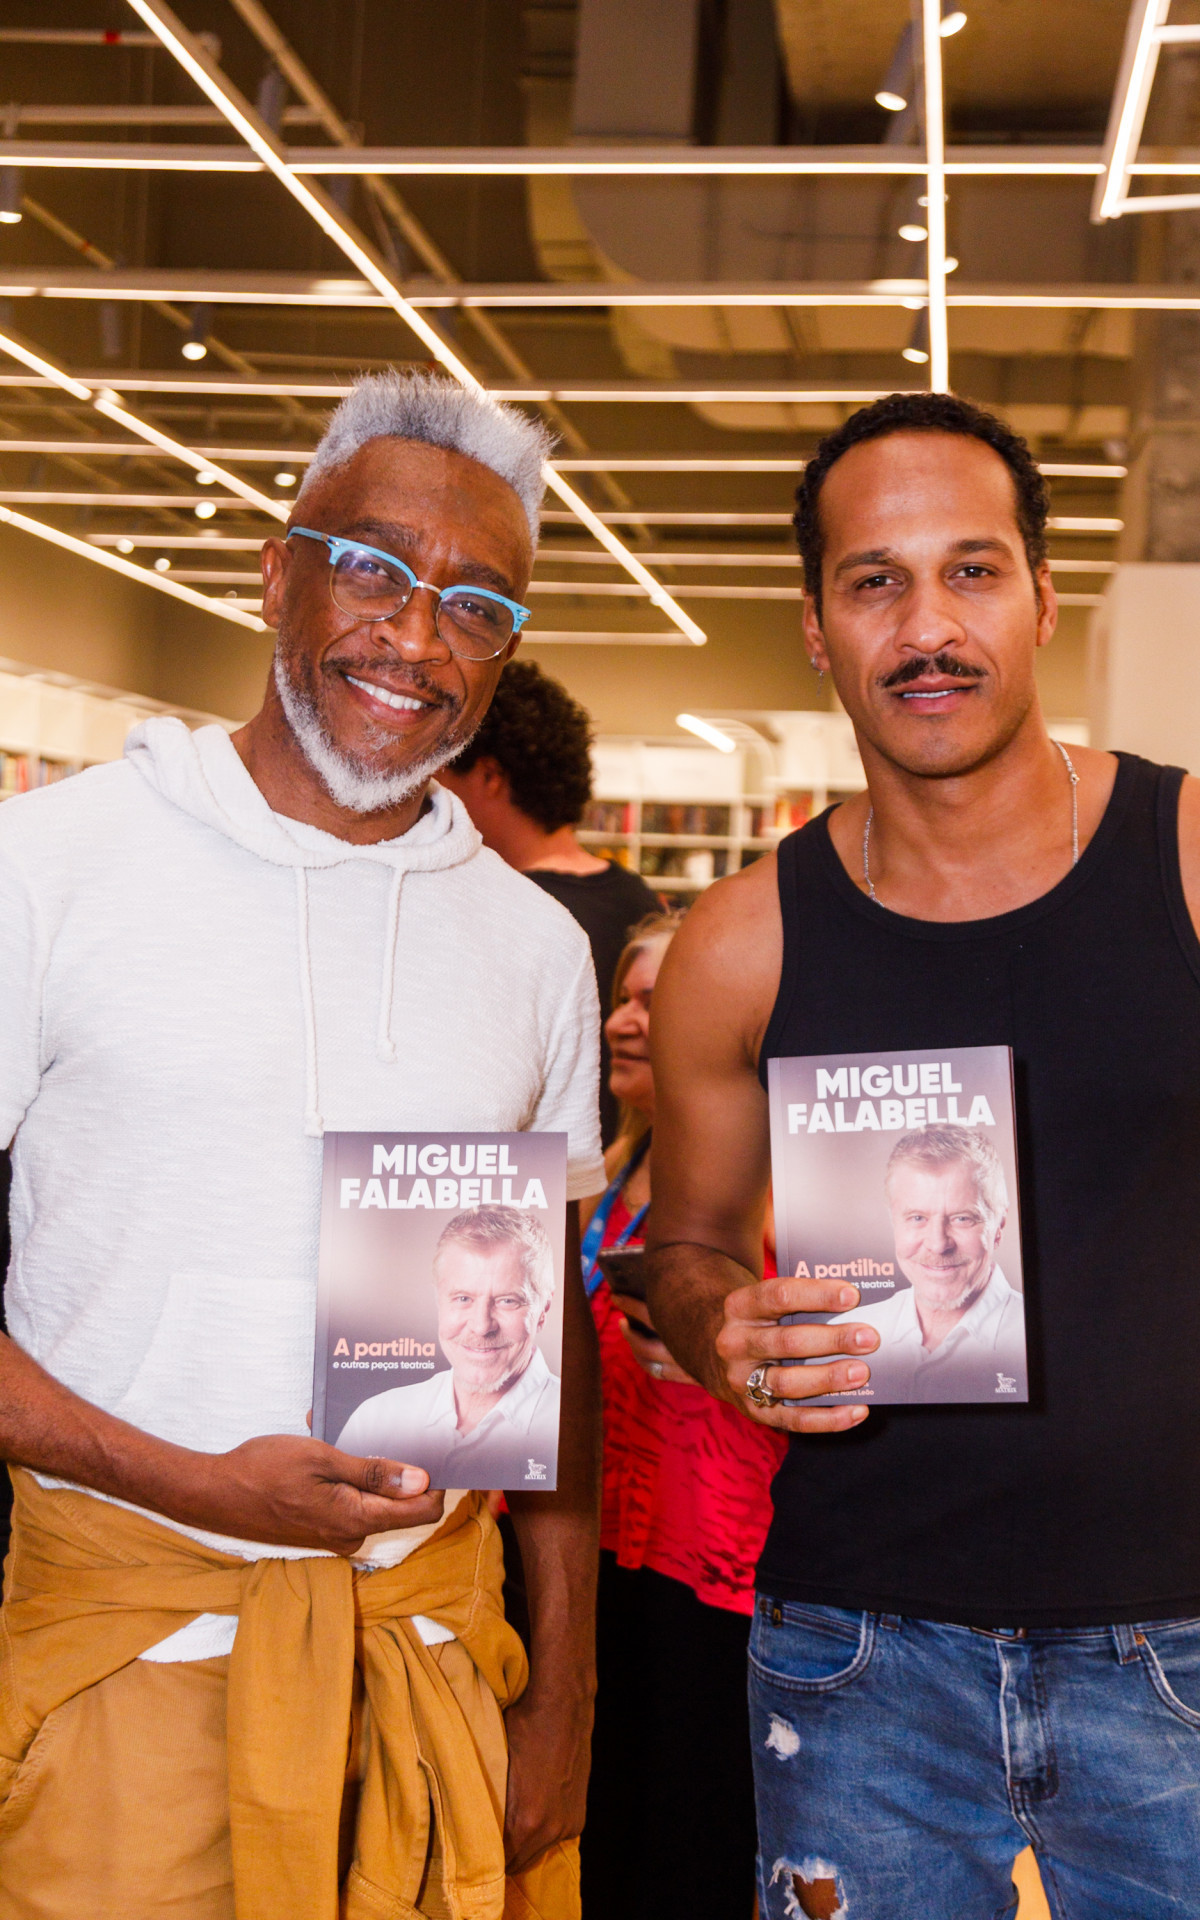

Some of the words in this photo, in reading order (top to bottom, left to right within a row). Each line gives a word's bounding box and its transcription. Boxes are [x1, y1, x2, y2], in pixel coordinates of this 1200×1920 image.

[815, 1062, 962, 1099] MIGUEL
[787, 1095, 995, 1134] FALABELLA
[372, 1144, 517, 1176] MIGUEL
[340, 1178, 548, 1209] FALABELLA
[794, 1260, 811, 1278] A
[814, 1258, 895, 1279] partilha
[860, 1280, 895, 1289] teatrais
[333, 1337, 350, 1356] A
[354, 1338, 436, 1361] partilha
[333, 1361, 339, 1369] e
[341, 1361, 369, 1369] outras
[371, 1361, 399, 1371] peças
[400, 1360, 435, 1369] teatrais
